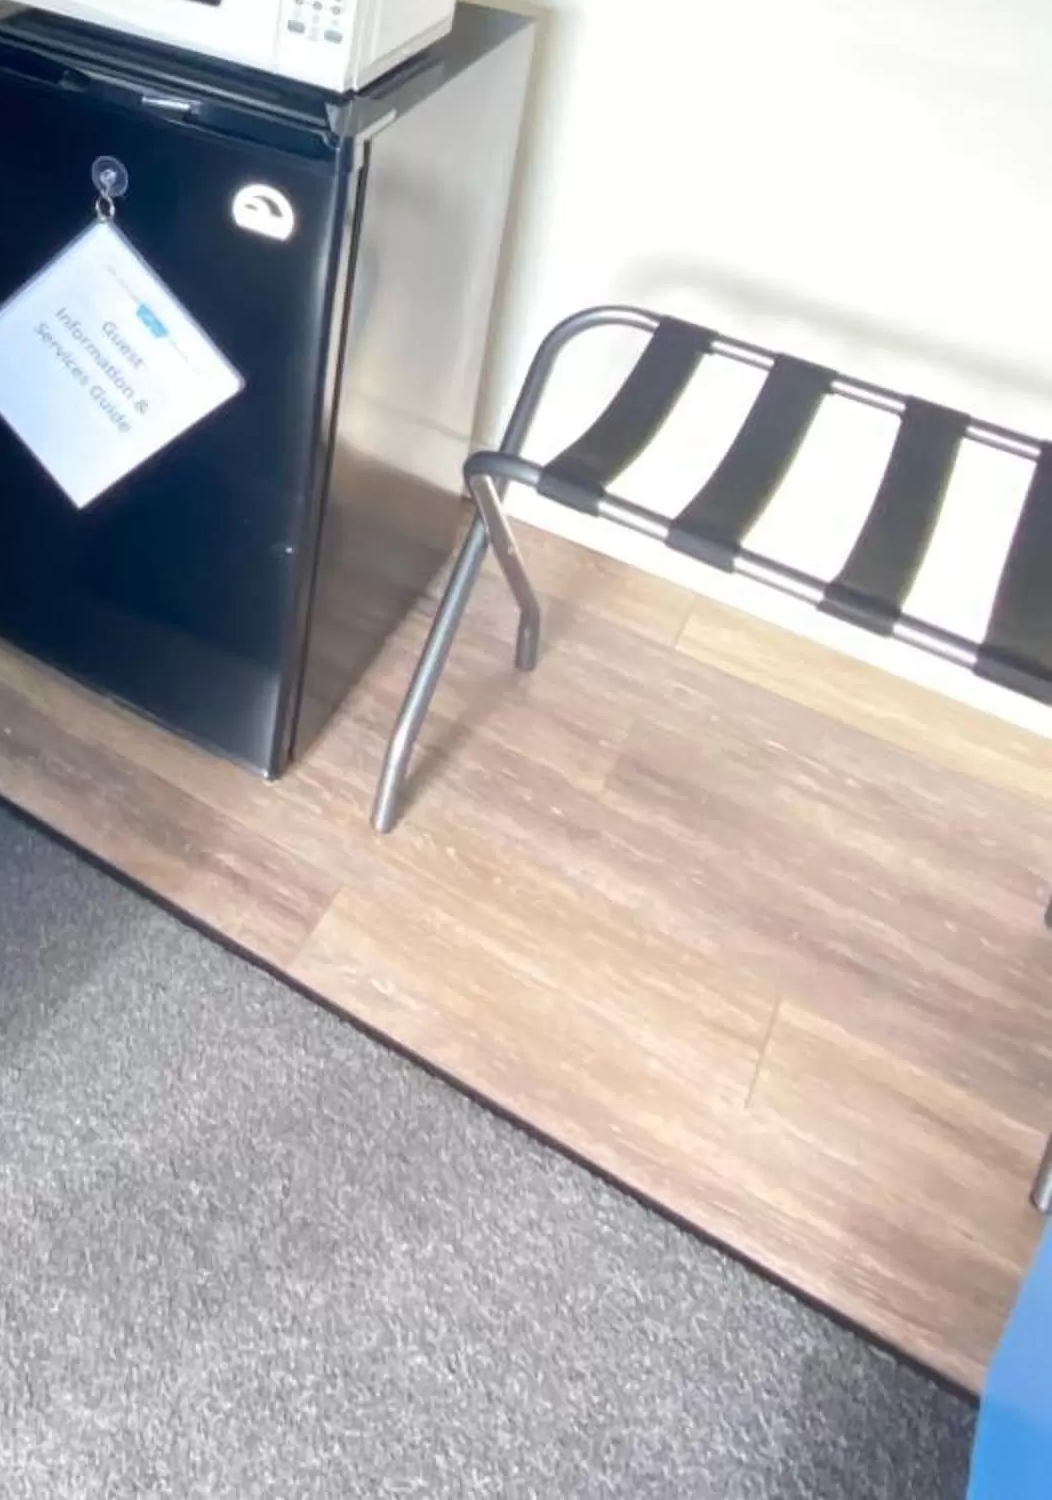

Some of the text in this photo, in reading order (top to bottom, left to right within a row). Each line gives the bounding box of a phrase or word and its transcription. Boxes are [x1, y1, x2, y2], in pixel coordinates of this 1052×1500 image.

[34, 323, 132, 432] Services Guide
[56, 308, 132, 399] Information
[135, 400, 149, 414] &
[101, 321, 144, 369] Guest
